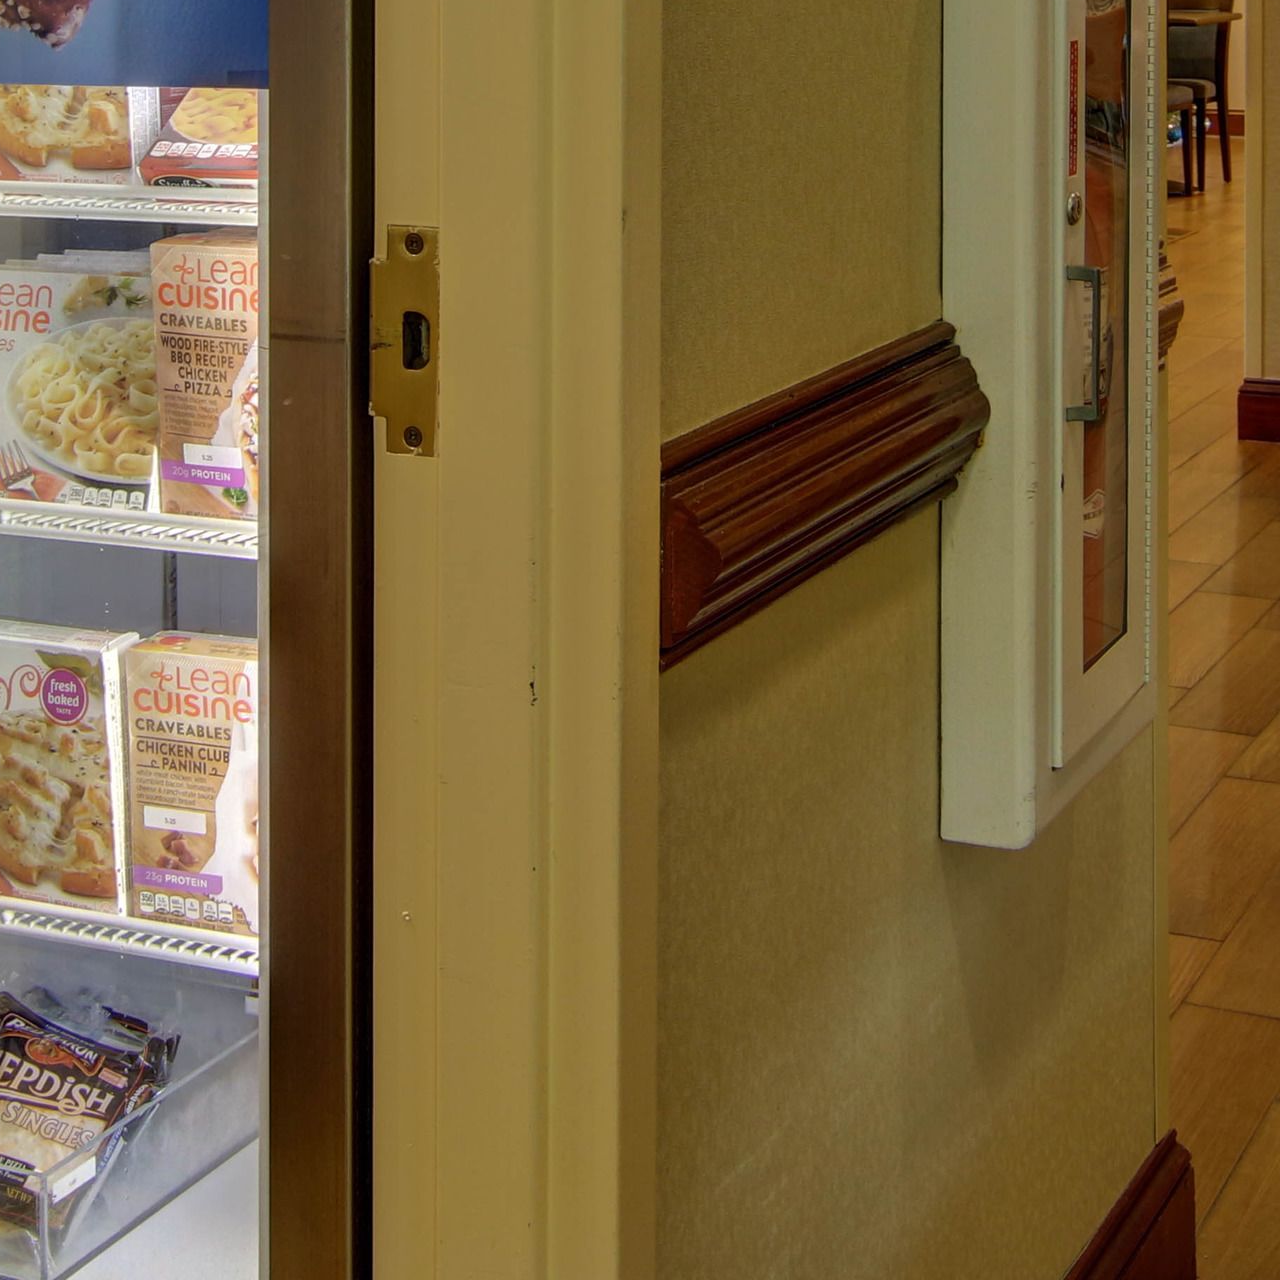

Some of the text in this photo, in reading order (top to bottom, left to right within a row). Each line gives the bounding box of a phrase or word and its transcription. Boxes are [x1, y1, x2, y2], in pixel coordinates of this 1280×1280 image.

[159, 312, 248, 333] CRAVEABLES
[160, 334, 249, 356] WOOD FIRE-STYLE
[170, 352, 235, 369] BBQ RECIPE
[177, 366, 228, 383] CHICKEN
[184, 382, 222, 397] PIZZA
[171, 465, 231, 482] 20g PROTEIN
[50, 678, 77, 694] fresh
[175, 666, 251, 697] Lean
[47, 692, 80, 707] baked
[135, 717, 232, 741] CRAVEABLES
[136, 739, 231, 765] CHICKEN CLUB
[161, 757, 208, 775] PANINI
[144, 870, 208, 889] 23g PROTEIN
[1, 1100, 96, 1151] SINGLES
